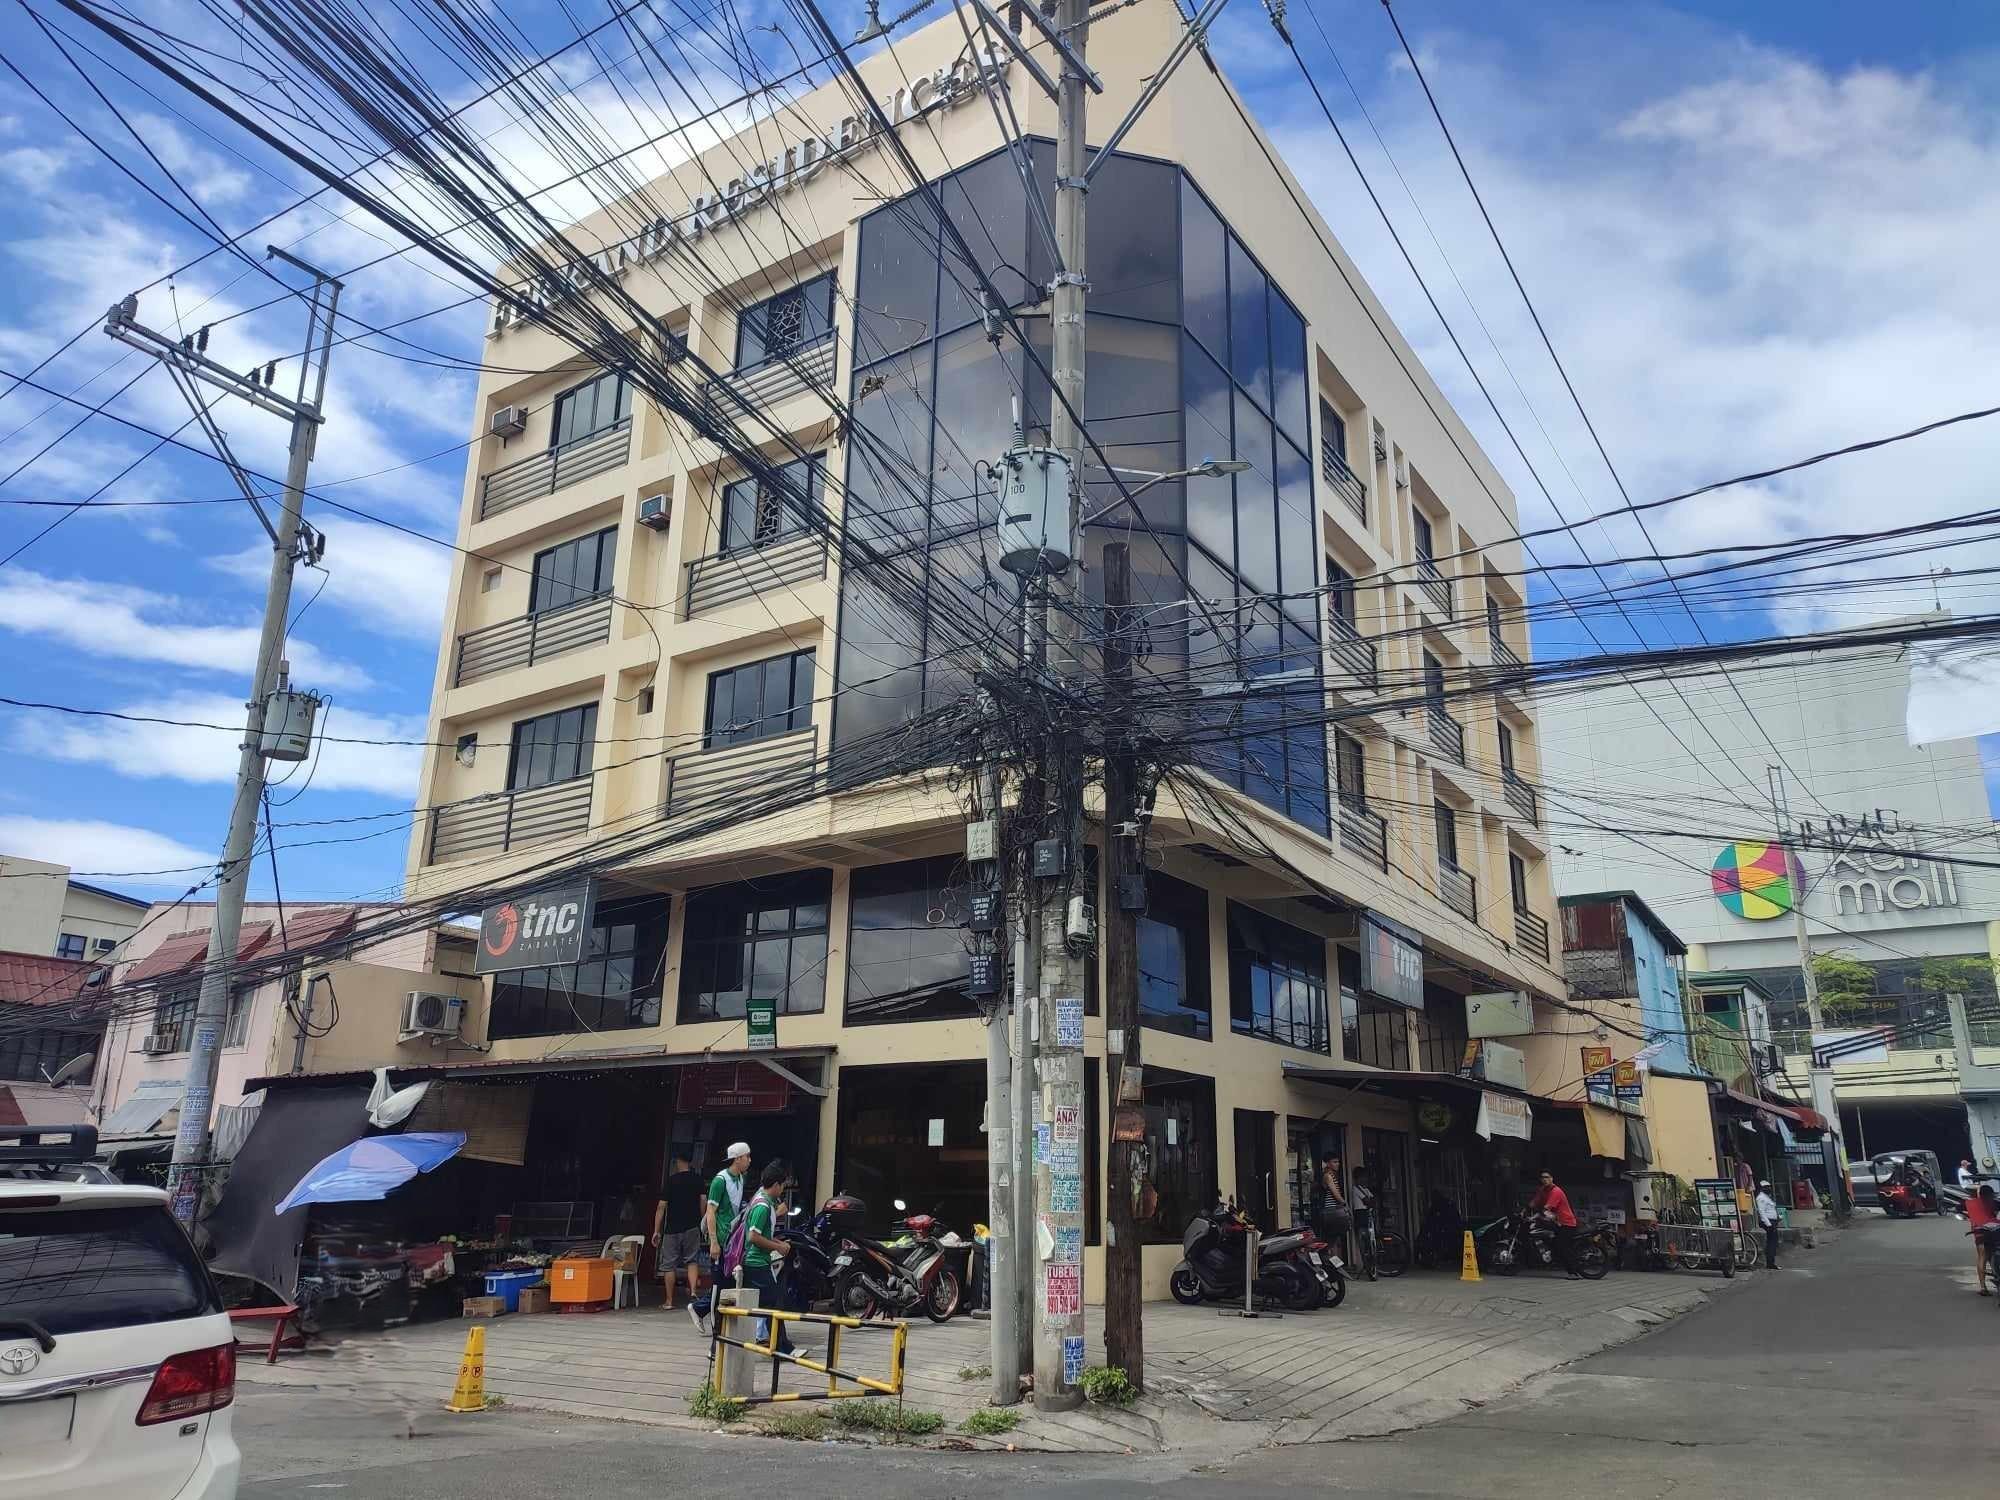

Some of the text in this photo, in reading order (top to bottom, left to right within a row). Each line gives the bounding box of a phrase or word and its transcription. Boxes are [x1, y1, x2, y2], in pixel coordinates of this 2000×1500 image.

[1010, 484, 1025, 496] 100
[1833, 861, 1958, 915] mall
[522, 902, 578, 938] tnc
[1056, 1111, 1078, 1124] ANAY
[1048, 1266, 1079, 1278] TUBERO
